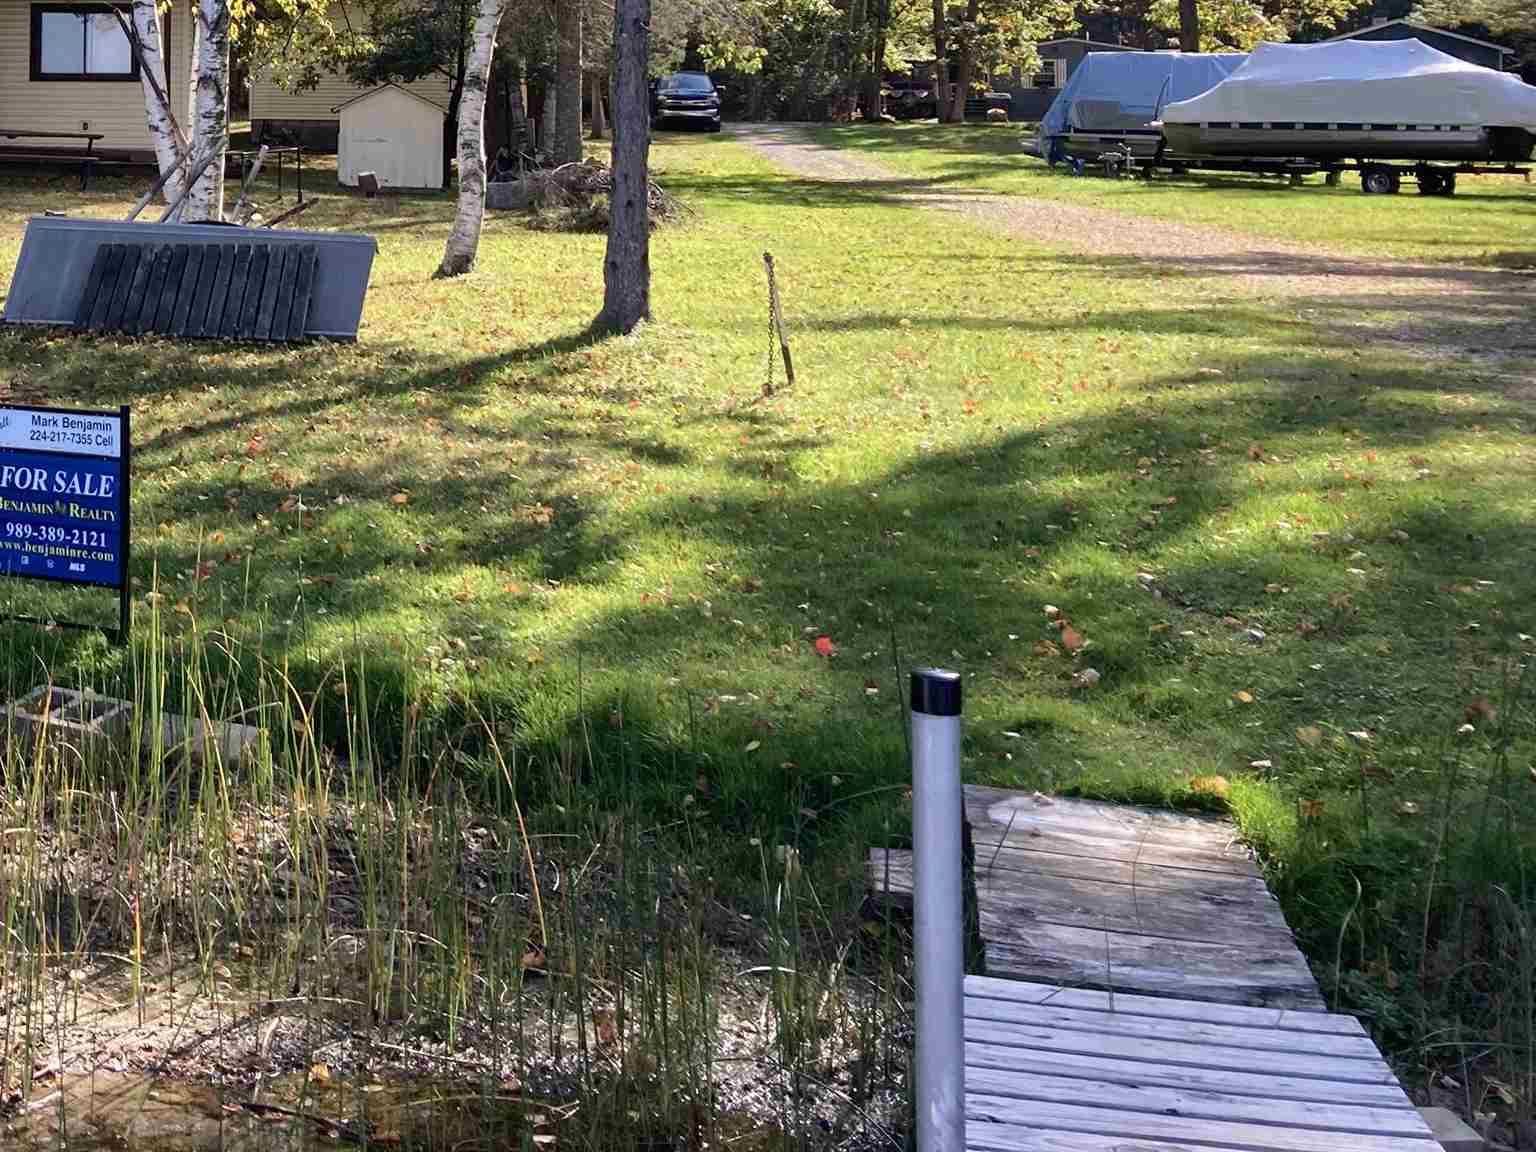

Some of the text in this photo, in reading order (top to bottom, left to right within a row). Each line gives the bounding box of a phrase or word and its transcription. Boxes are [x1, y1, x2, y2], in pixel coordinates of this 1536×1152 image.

[31, 414, 112, 433] Mark Benjamin
[29, 430, 113, 447] 224-217-7355 Cell
[0, 465, 114, 498] FOR SALE
[69, 503, 117, 523] REALTY
[5, 521, 107, 548] 989-389-2121
